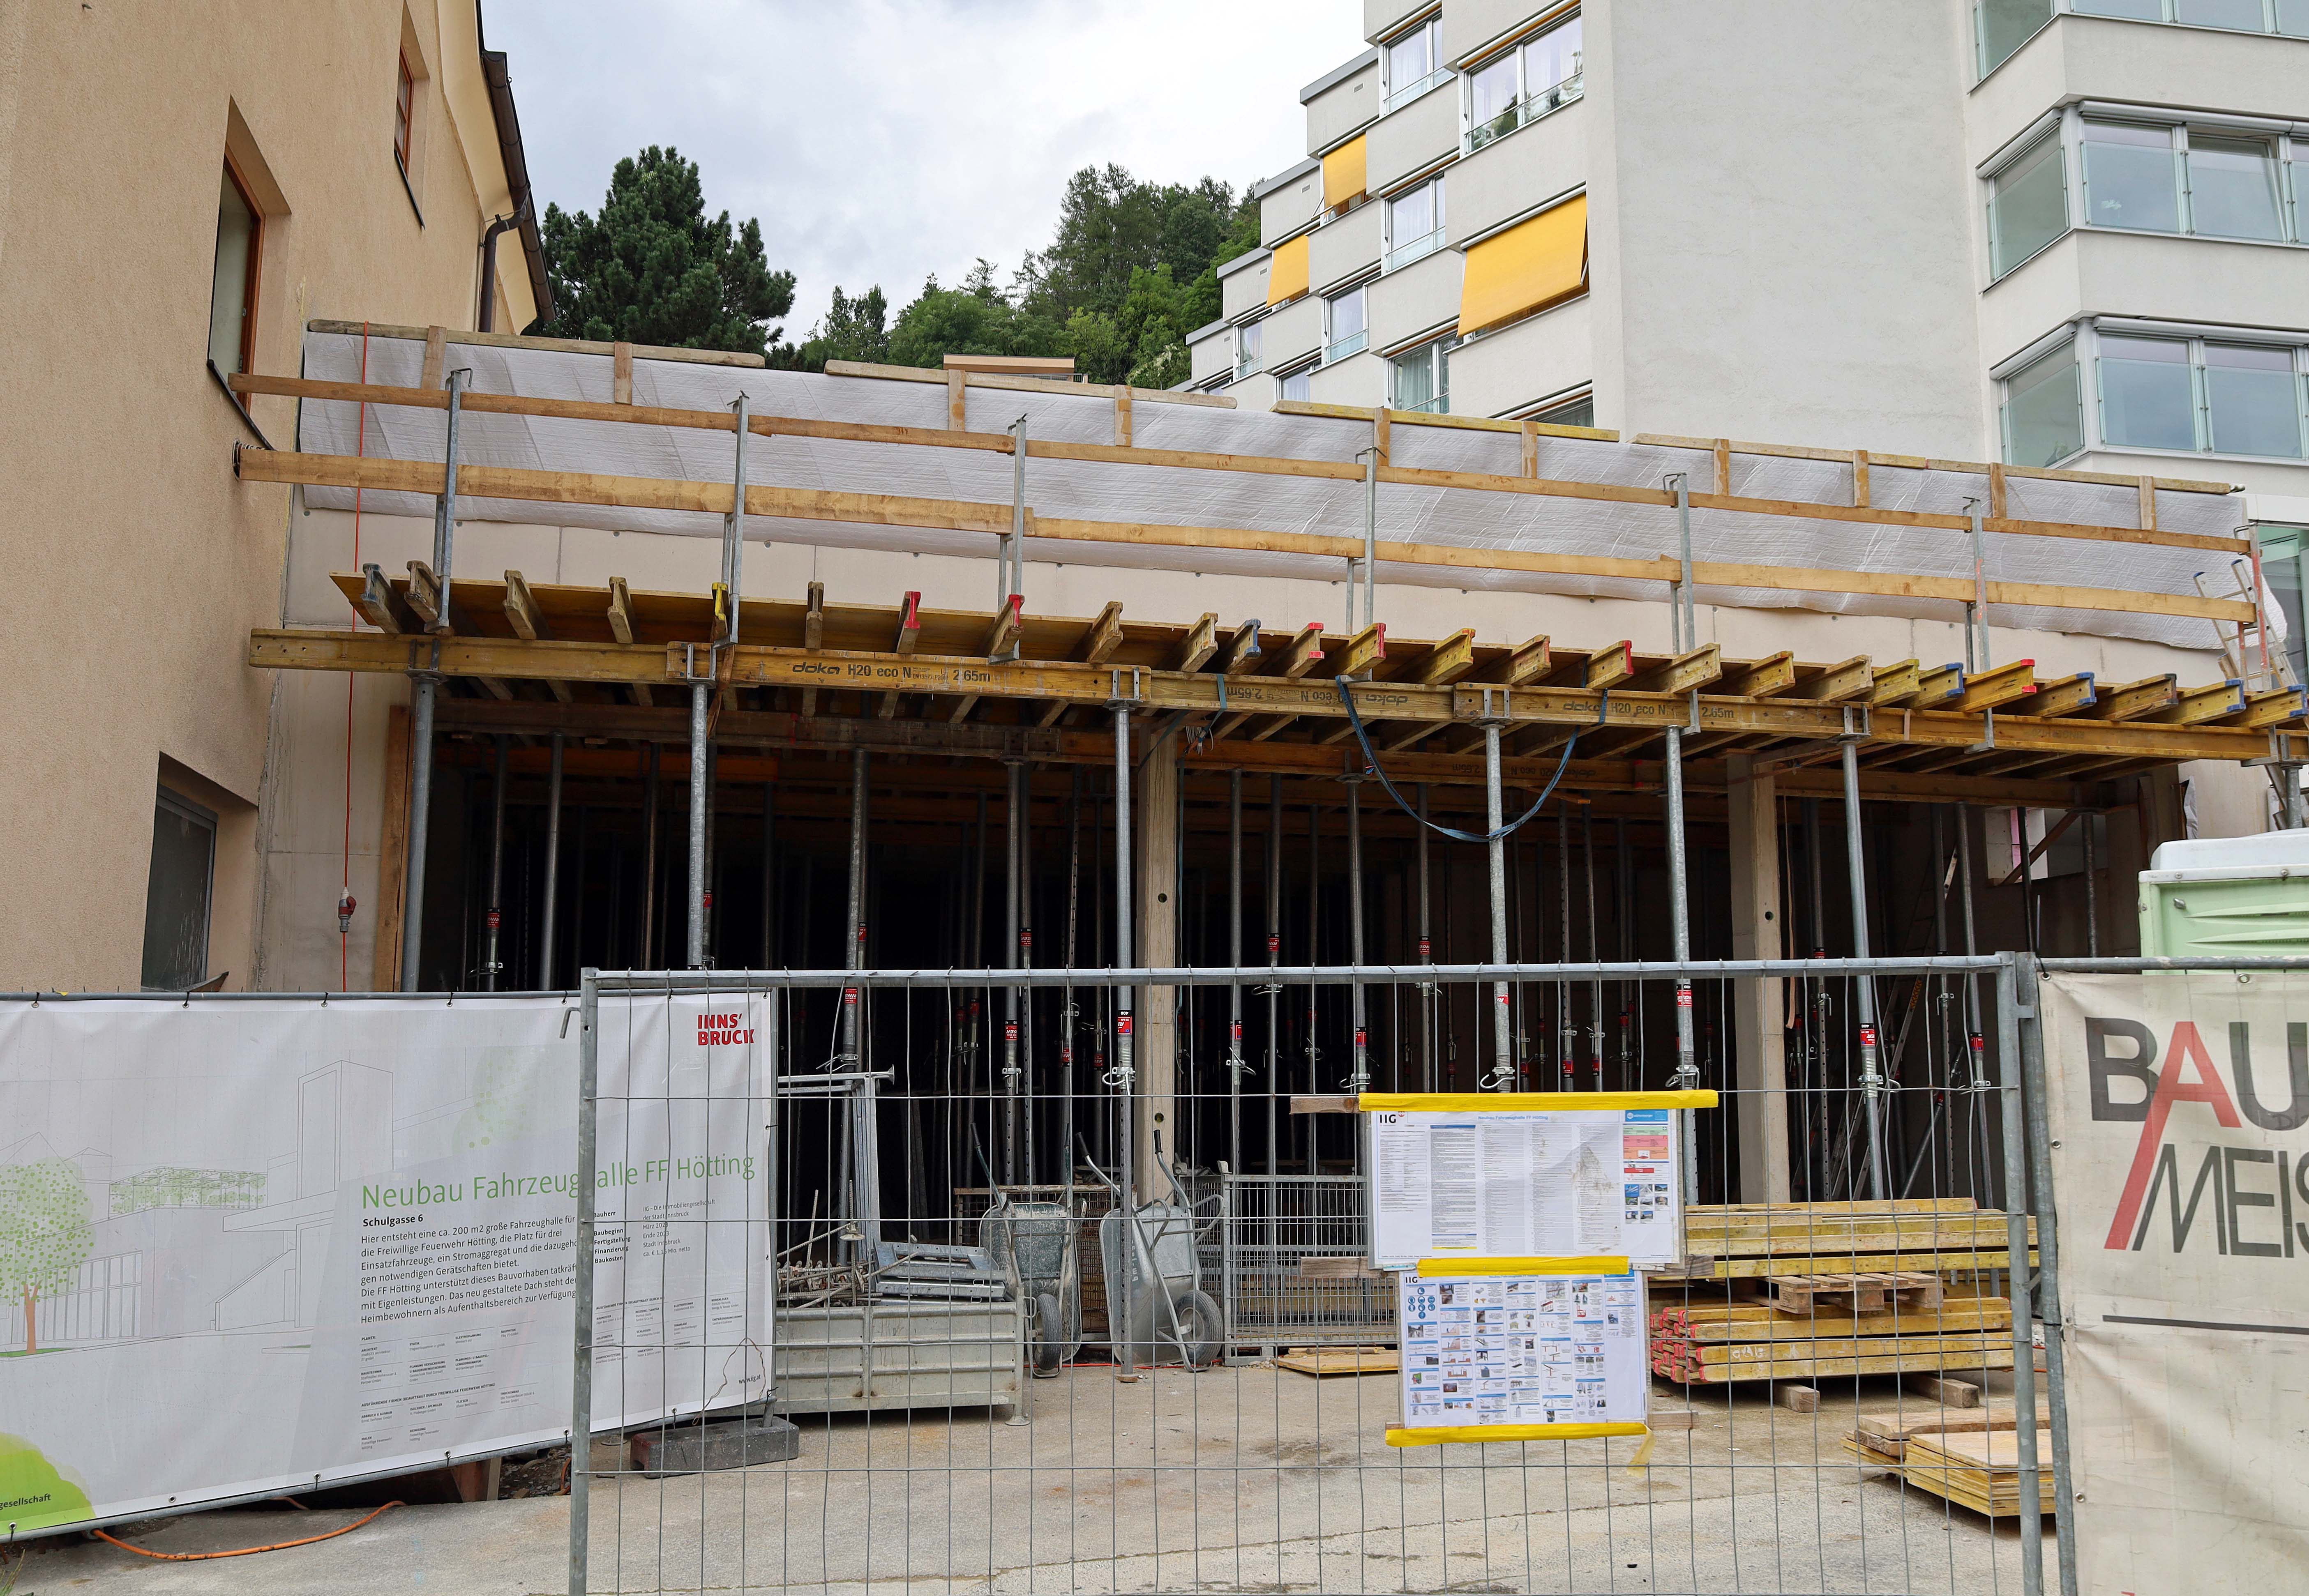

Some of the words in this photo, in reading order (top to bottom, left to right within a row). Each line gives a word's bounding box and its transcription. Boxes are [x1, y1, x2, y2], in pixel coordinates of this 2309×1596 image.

[792, 662, 840, 675] doka
[848, 664, 871, 676] H20
[877, 666, 898, 677] eco
[904, 667, 911, 678] N
[1225, 686, 1262, 700] 2.65m
[1301, 691, 1309, 702] N
[1313, 691, 1331, 703] eco
[1337, 693, 1359, 705] H0
[1366, 694, 1408, 706] doka
[1610, 702, 1631, 714] H20
[1636, 705, 1654, 715] eco
[1658, 705, 1665, 715] N
[698, 1013, 742, 1029] INNS'
[698, 1029, 755, 1046] BRUCK
[1379, 1114, 1397, 1124] IIG
[363, 1178, 462, 1209] Neubau
[473, 1161, 638, 1200] Fahrzeugalle
[646, 1160, 669, 1183] FF
[678, 1153, 755, 1180] Hötting
[363, 1216, 415, 1227] Schulgasse
[418, 1214, 423, 1222] 6
[666, 1210, 690, 1218] nnsbruck
[362, 1235, 379, 1244] Hier
[381, 1231, 416, 1242] entsteht
[418, 1230, 436, 1238] eine
[452, 1226, 468, 1235] 200
[471, 1225, 484, 1233] m2
[486, 1222, 508, 1234] große
[510, 1216, 563, 1230] Fahrzeughalle
[565, 1215, 575, 1223] für
[594, 1228, 624, 1237] Baubeginn
[361, 1248, 375, 1257] die
[377, 1244, 419, 1255] Freiwillige
[421, 1239, 465, 1251] Feuerwehr
[467, 1237, 498, 1246] Hötting,
[500, 1234, 512, 1243] die
[514, 1232, 533, 1241] Platz
[535, 1230, 547, 1239] für
[548, 1229, 562, 1238] drei
[361, 1257, 435, 1270] Einsatzfahrzeuge,
[437, 1254, 450, 1262] ein
[453, 1247, 511, 1261] Stromaggregat
[513, 1244, 528, 1254] und
[530, 1244, 542, 1252] die
[361, 1276, 376, 1286] gen
[379, 1269, 433, 1282] notwendigen
[436, 1262, 491, 1276] Gerätschaften
[494, 1259, 519, 1269] bietet.
[361, 1288, 375, 1297] Die
[378, 1286, 388, 1295] FF
[390, 1283, 421, 1294] Hötting
[423, 1278, 469, 1290] unterstützt
[471, 1275, 496, 1284] dieses
[498, 1268, 549, 1281] Bauvorhaben
[551, 1263, 576, 1274] tatkräf
[361, 1301, 376, 1310] mit
[378, 1294, 447, 1310] Eigenleistungen.
[482, 1284, 522, 1298] gestaltete
[524, 1280, 542, 1290] Dach
[544, 1278, 563, 1288] steht
[565, 1276, 576, 1285] de
[361, 1309, 431, 1324] Heimbewohnern
[434, 1306, 445, 1315] als
[447, 1295, 523, 1313] Aufenthaltsbereich
[738, 1374, 761, 1384] www.iig.at
